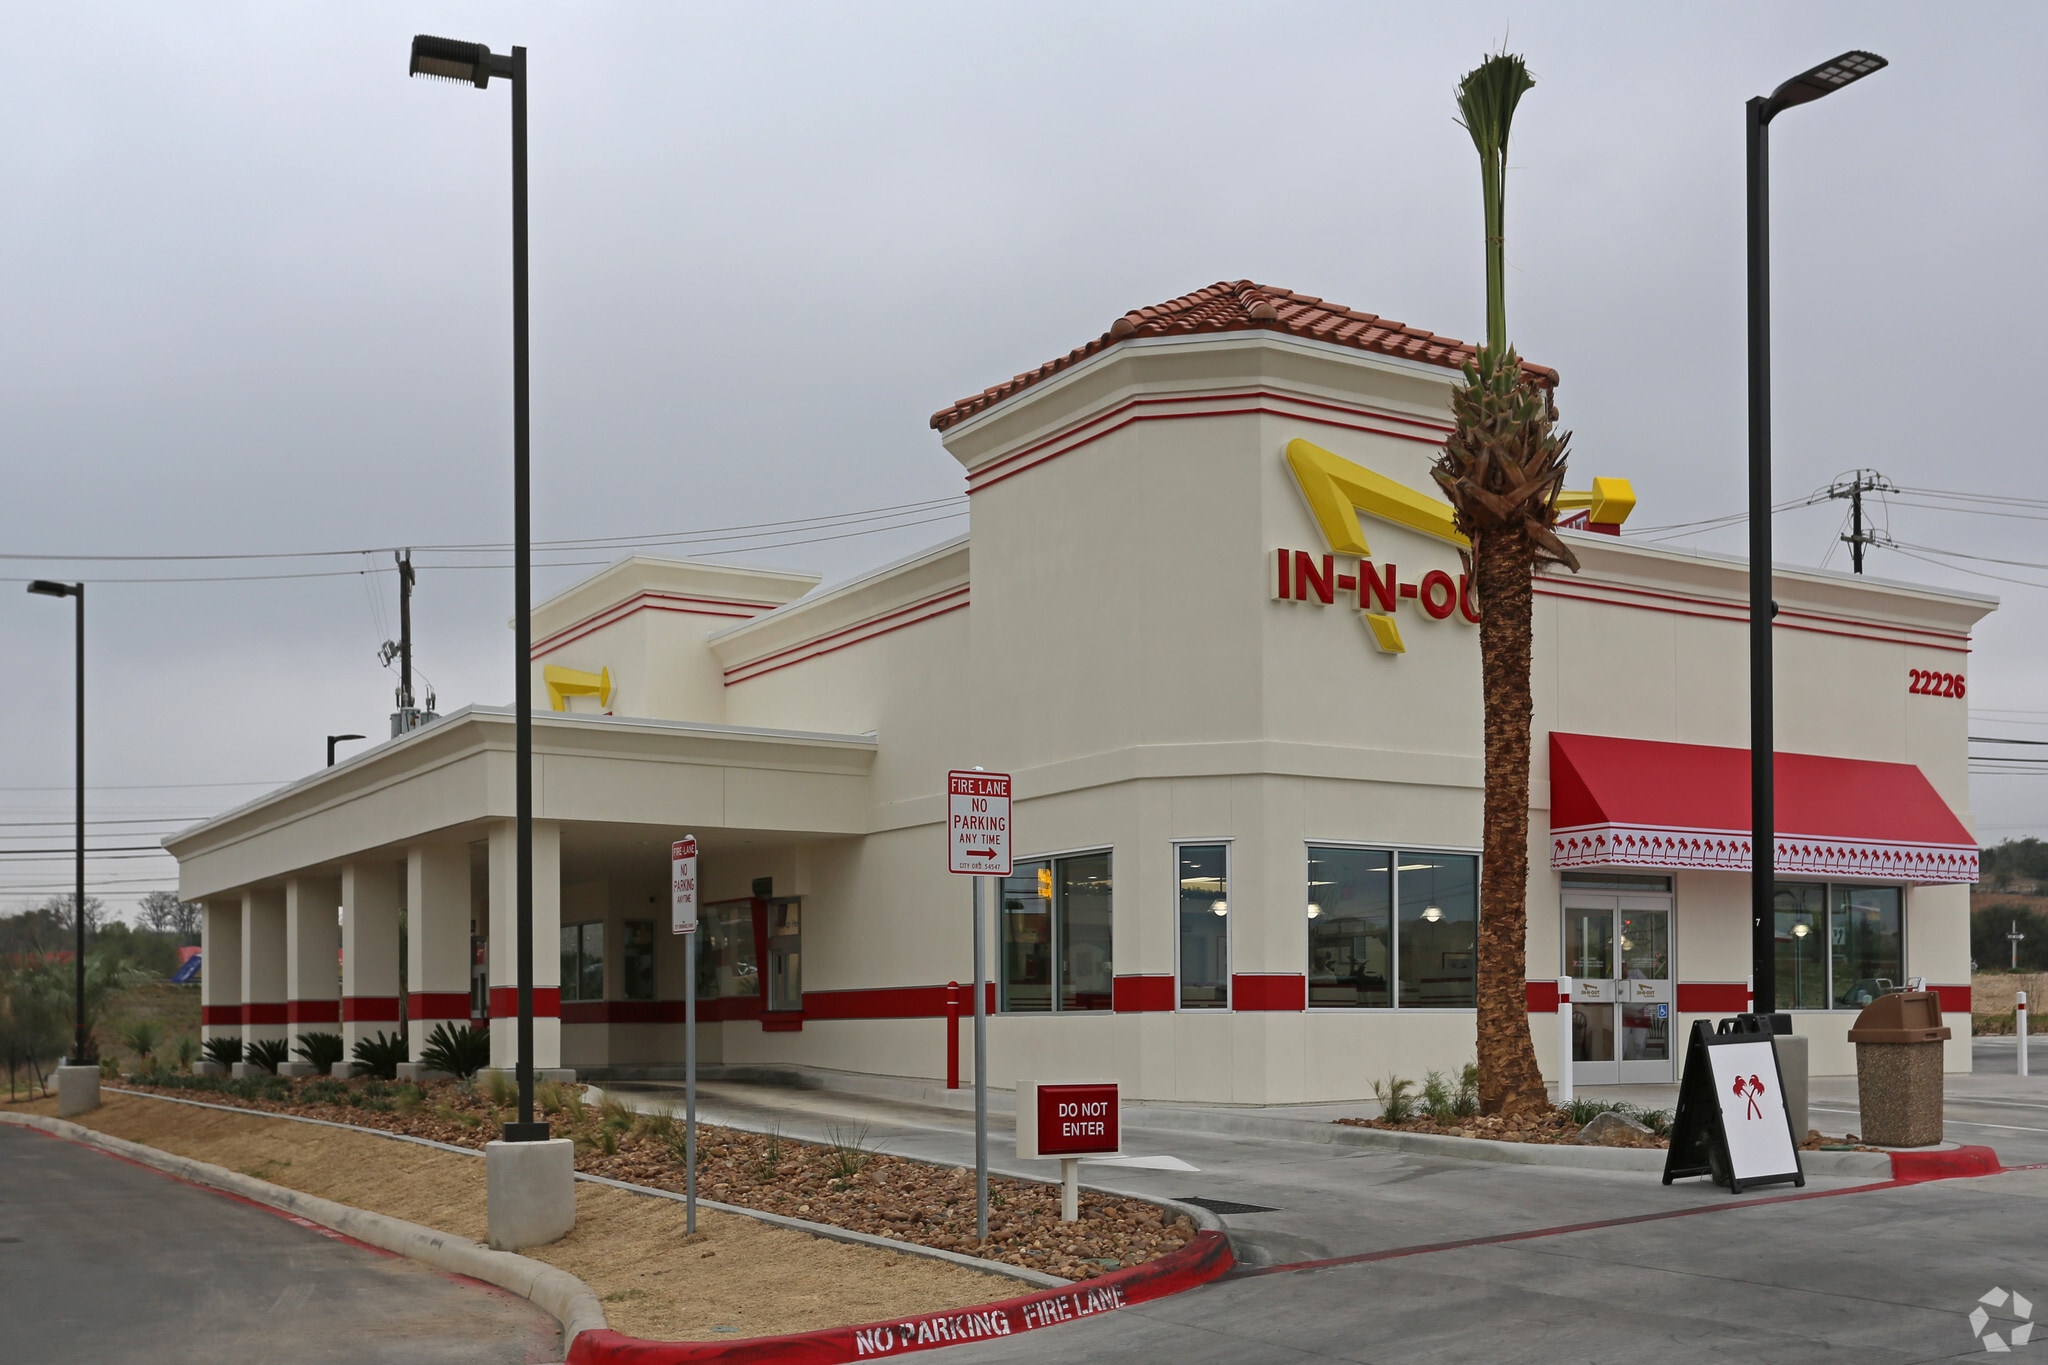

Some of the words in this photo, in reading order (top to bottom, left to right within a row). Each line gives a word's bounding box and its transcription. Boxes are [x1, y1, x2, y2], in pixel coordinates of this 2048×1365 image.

[1275, 548, 1480, 623] IN-N-OU
[1909, 668, 1965, 699] 22226
[951, 779, 974, 793] FIRE
[978, 781, 1007, 795] LANE
[971, 798, 988, 813] NO
[954, 815, 1005, 832] PARKING
[959, 833, 978, 844] ANY
[981, 834, 1000, 845] TIME
[680, 864, 688, 876] NO
[673, 878, 694, 893] PARKING
[1755, 918, 1761, 927] 7
[1059, 1103, 1078, 1117] DO
[1082, 1102, 1108, 1116] NOT
[1063, 1122, 1105, 1137] ENTER
[856, 1326, 894, 1355] NO
[899, 1310, 1010, 1347] PARKING
[1022, 1295, 1072, 1329] FIRE
[1075, 1285, 1126, 1316] LANE
